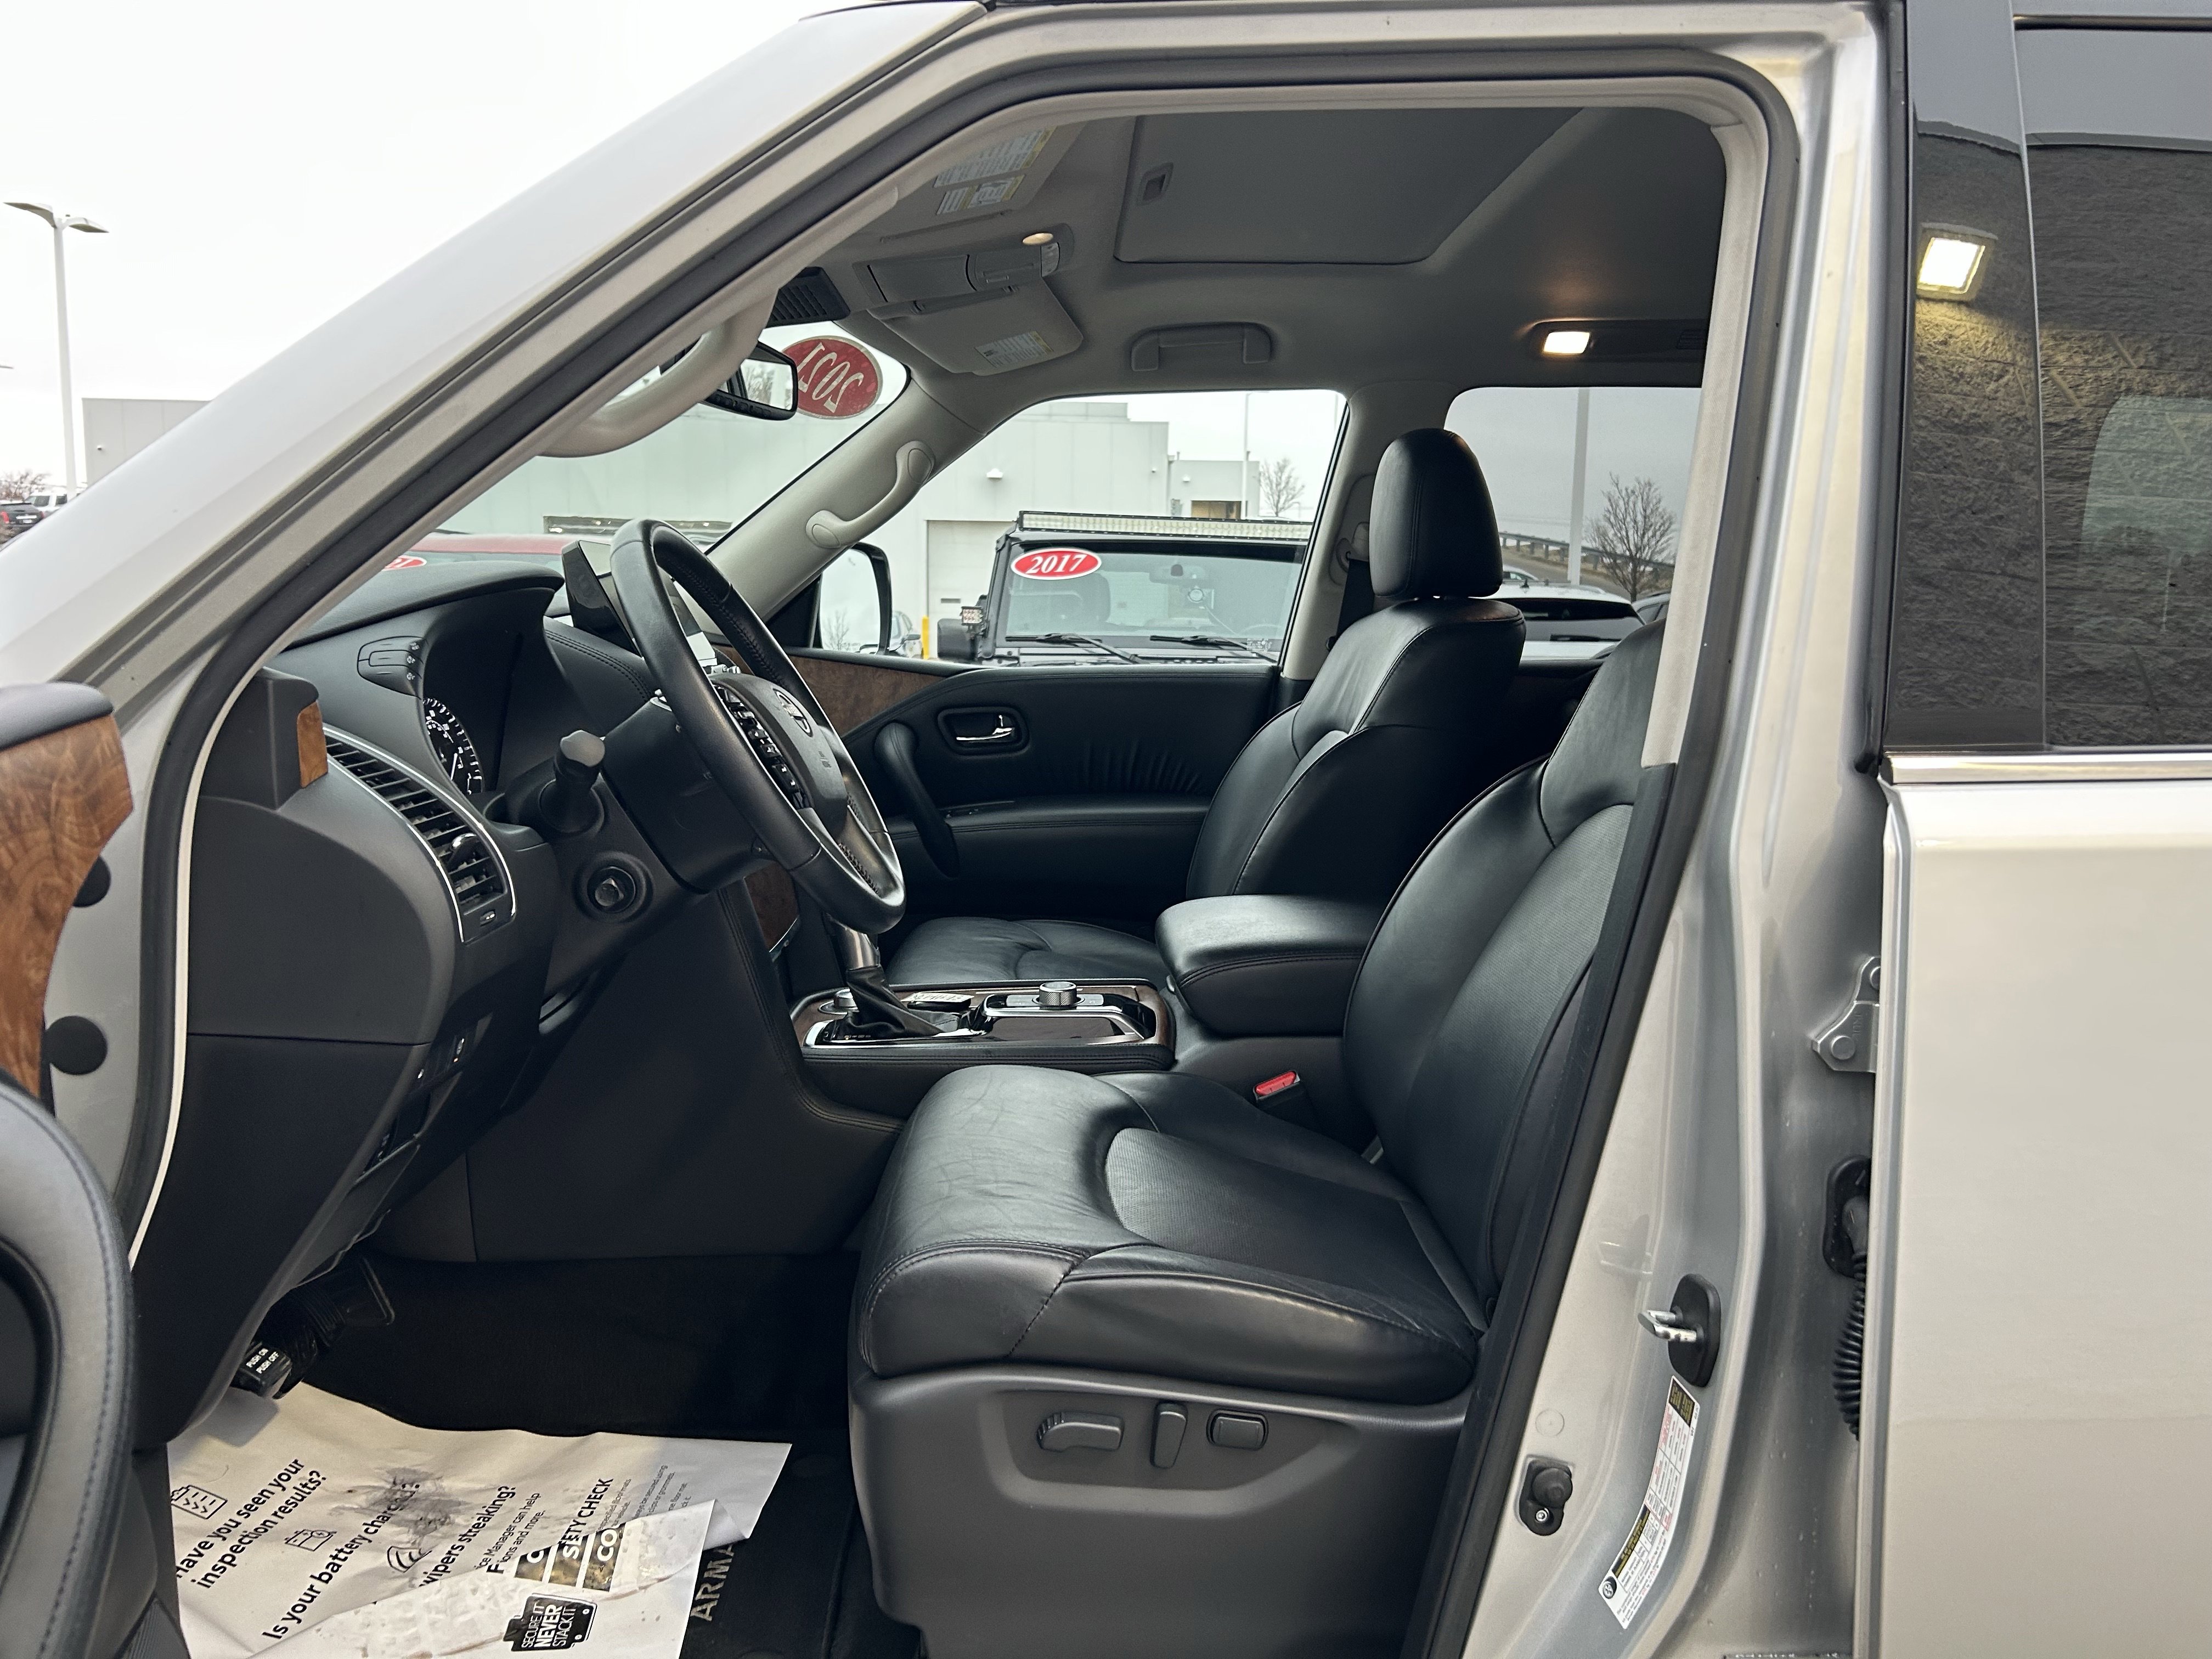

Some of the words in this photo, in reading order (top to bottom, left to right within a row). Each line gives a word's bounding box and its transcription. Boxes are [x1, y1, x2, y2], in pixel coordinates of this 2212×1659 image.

[1025, 554, 1087, 574] 2017
[206, 1518, 242, 1541] you
[236, 1488, 275, 1519] seen
[268, 1459, 304, 1492] your
[458, 1486, 516, 1543] streaking?
[518, 1493, 541, 1510] help
[578, 1478, 614, 1517] CHECK
[190, 1518, 279, 1588] inspection
[271, 1470, 326, 1519] results?
[513, 1511, 528, 1523] can
[514, 1531, 530, 1545] and
[524, 1510, 546, 1530] more.
[483, 1524, 517, 1556] Manager
[262, 1624, 289, 1639] Is
[281, 1584, 321, 1624] your
[309, 1534, 373, 1584] battery
[521, 1615, 543, 1648] SECURE
[532, 1599, 545, 1615] IT
[534, 1604, 563, 1648] NEVER
[561, 1606, 577, 1616] IT
[552, 1616, 575, 1647] STACK
